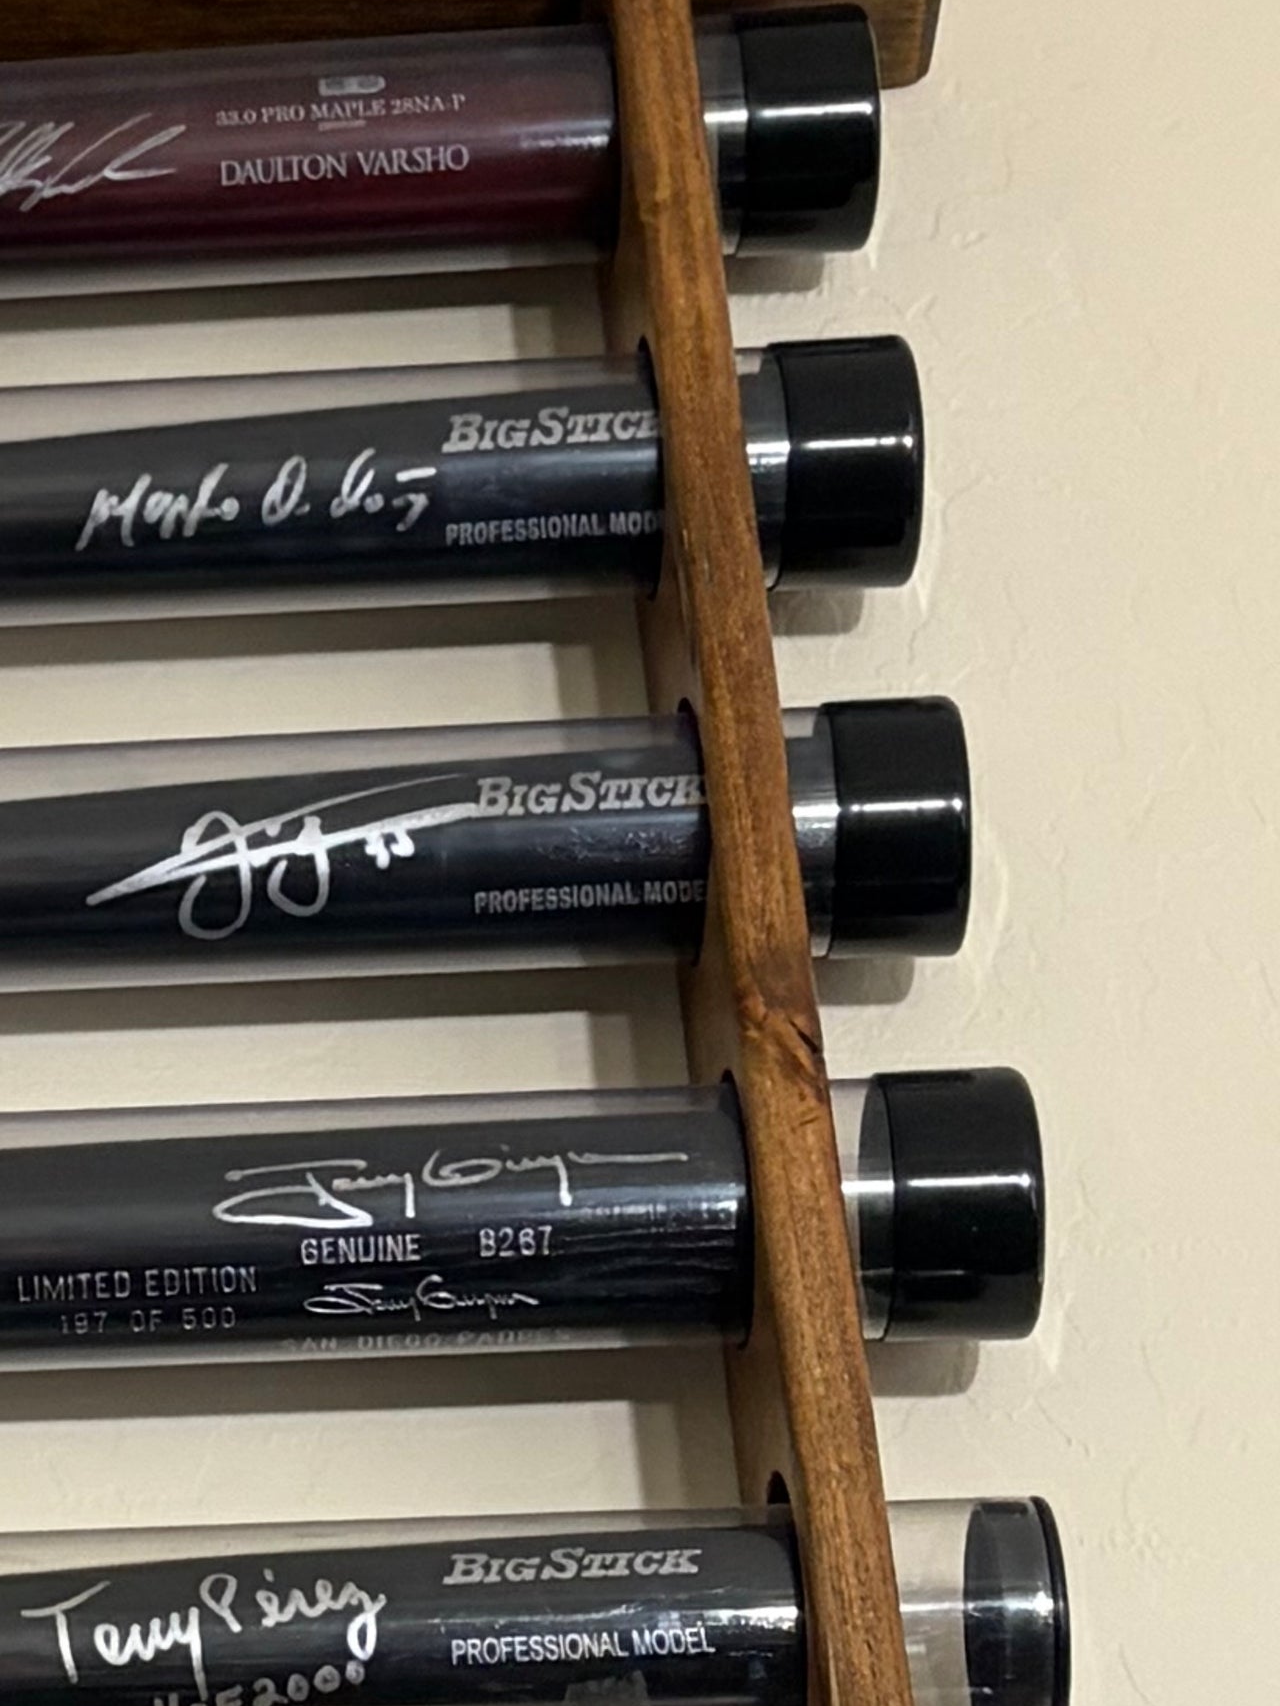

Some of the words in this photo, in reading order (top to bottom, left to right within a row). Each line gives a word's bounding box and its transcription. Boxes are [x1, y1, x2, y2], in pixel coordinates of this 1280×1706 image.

[261, 103, 305, 124] PRO
[310, 97, 387, 121] MAPLE
[220, 152, 347, 186] DAULTON
[357, 143, 470, 177] VARSHO
[445, 515, 606, 548] PROFESSIONAL
[609, 509, 659, 537] MOD
[474, 883, 639, 916] PROFESSIONAL
[643, 880, 706, 905] MODE
[299, 1233, 422, 1266] GENUINE
[17, 1270, 132, 1303] LIMITED
[144, 1265, 258, 1297] EDITION
[131, 1308, 163, 1333] OF
[181, 1306, 237, 1331] 500
[441, 1546, 702, 1586] BIGSTICK
[450, 1629, 630, 1667] PROFESSIONAL
[631, 1622, 717, 1657] MODEL
